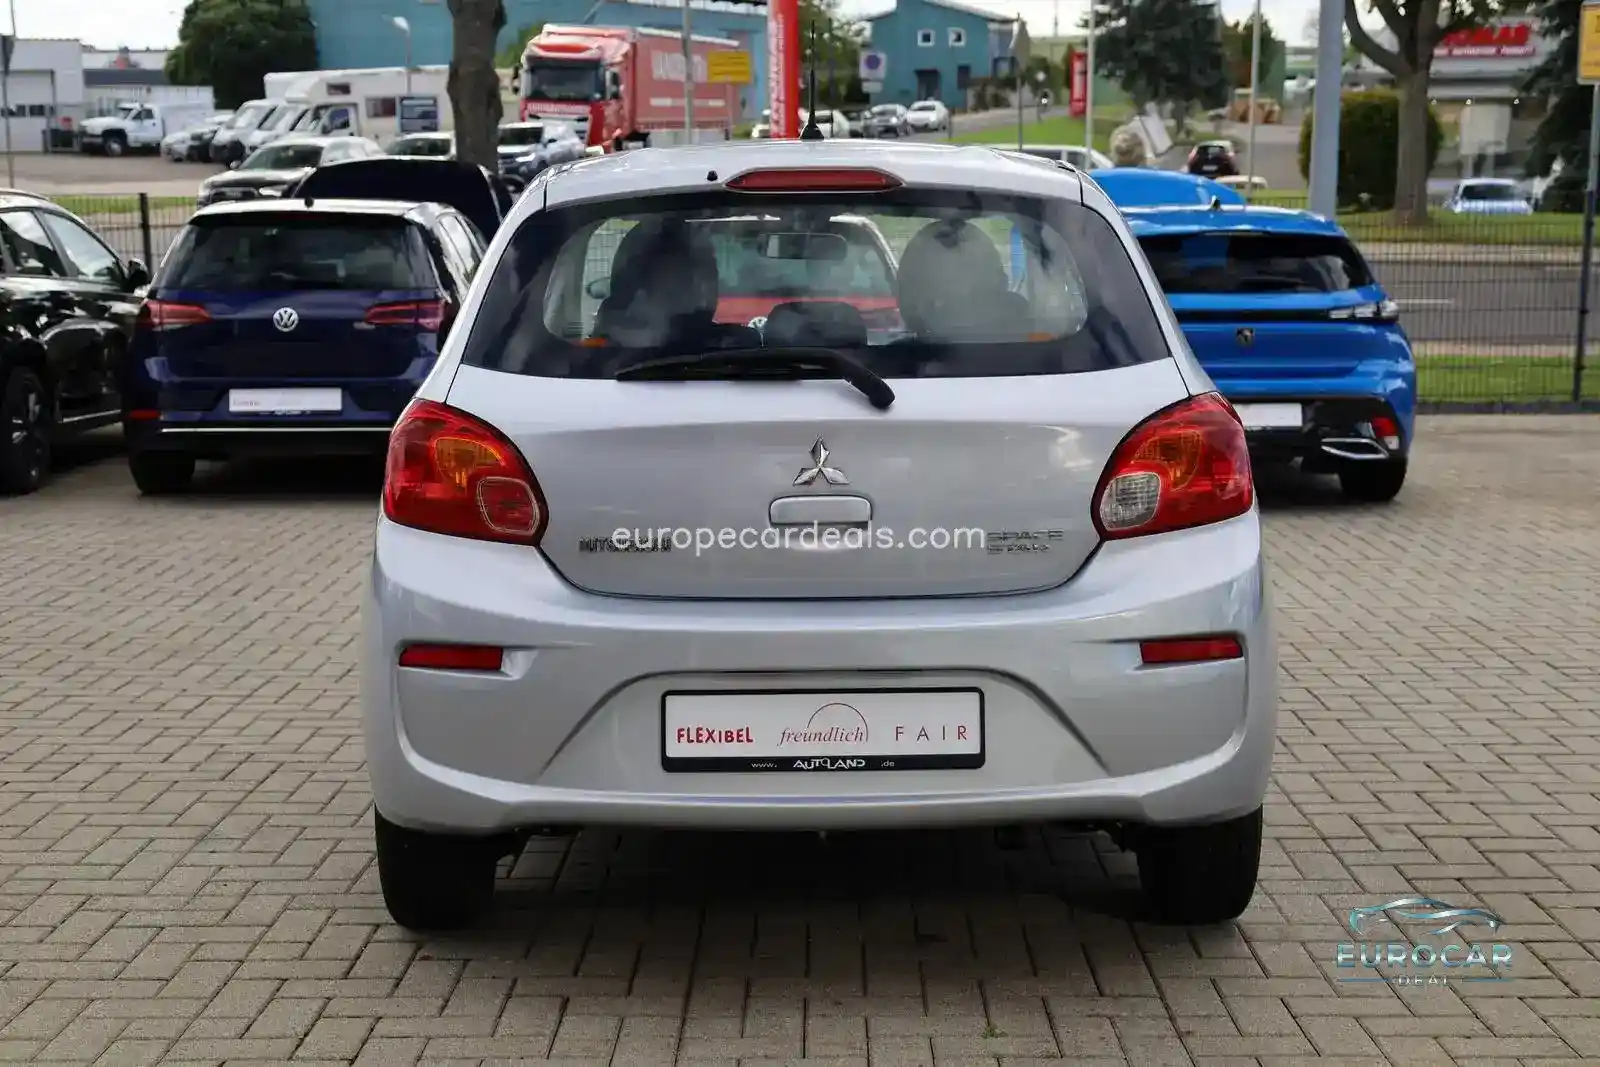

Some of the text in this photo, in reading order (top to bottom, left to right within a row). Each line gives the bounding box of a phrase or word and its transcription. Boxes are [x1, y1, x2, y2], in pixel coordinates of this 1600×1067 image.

[676, 725, 968, 747] FLEXIBEL freundlich FAIR
[793, 757, 867, 770] AUTOLAND
